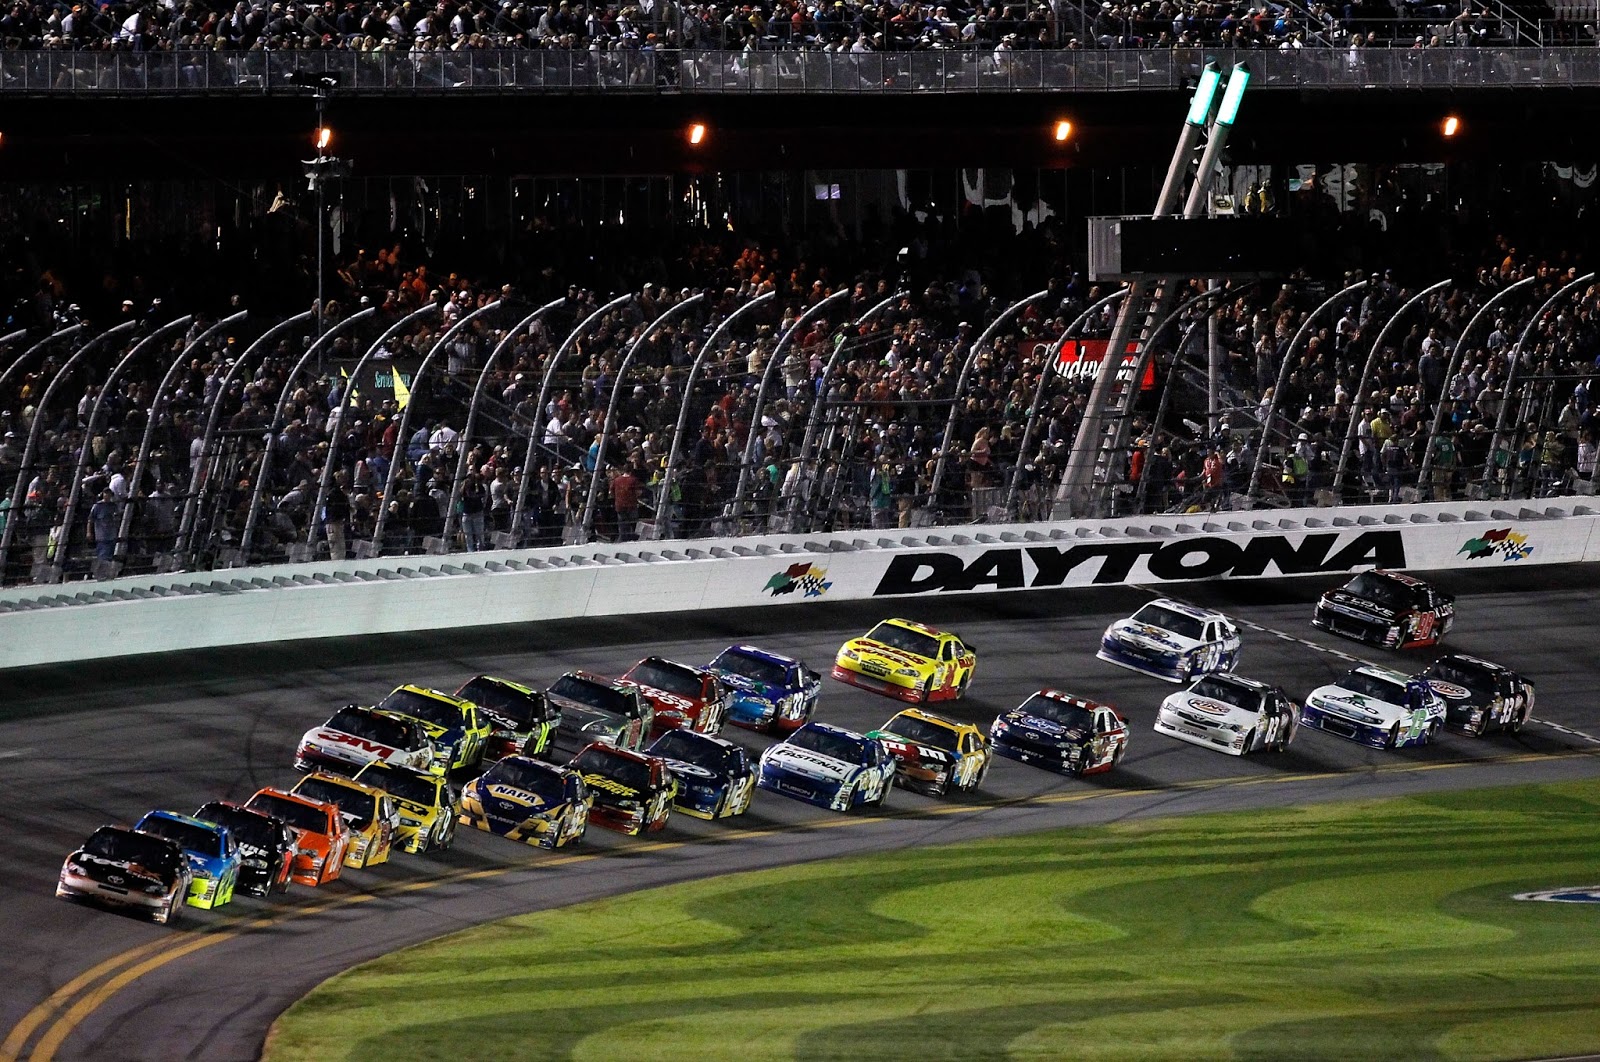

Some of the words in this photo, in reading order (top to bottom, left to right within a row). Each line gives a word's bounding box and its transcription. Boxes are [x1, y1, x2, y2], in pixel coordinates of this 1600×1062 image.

[873, 530, 1406, 596] DAYTONA
[789, 691, 804, 720] 33
[1322, 694, 1379, 716] GEICO
[1026, 717, 1061, 734] Kroger
[1176, 726, 1208, 741] CAMRY
[317, 730, 396, 760] 3M
[1009, 744, 1045, 760] CAMRY
[776, 747, 843, 775] FASTENAL
[495, 785, 536, 804] NAPA
[80, 853, 162, 880] FedEx
